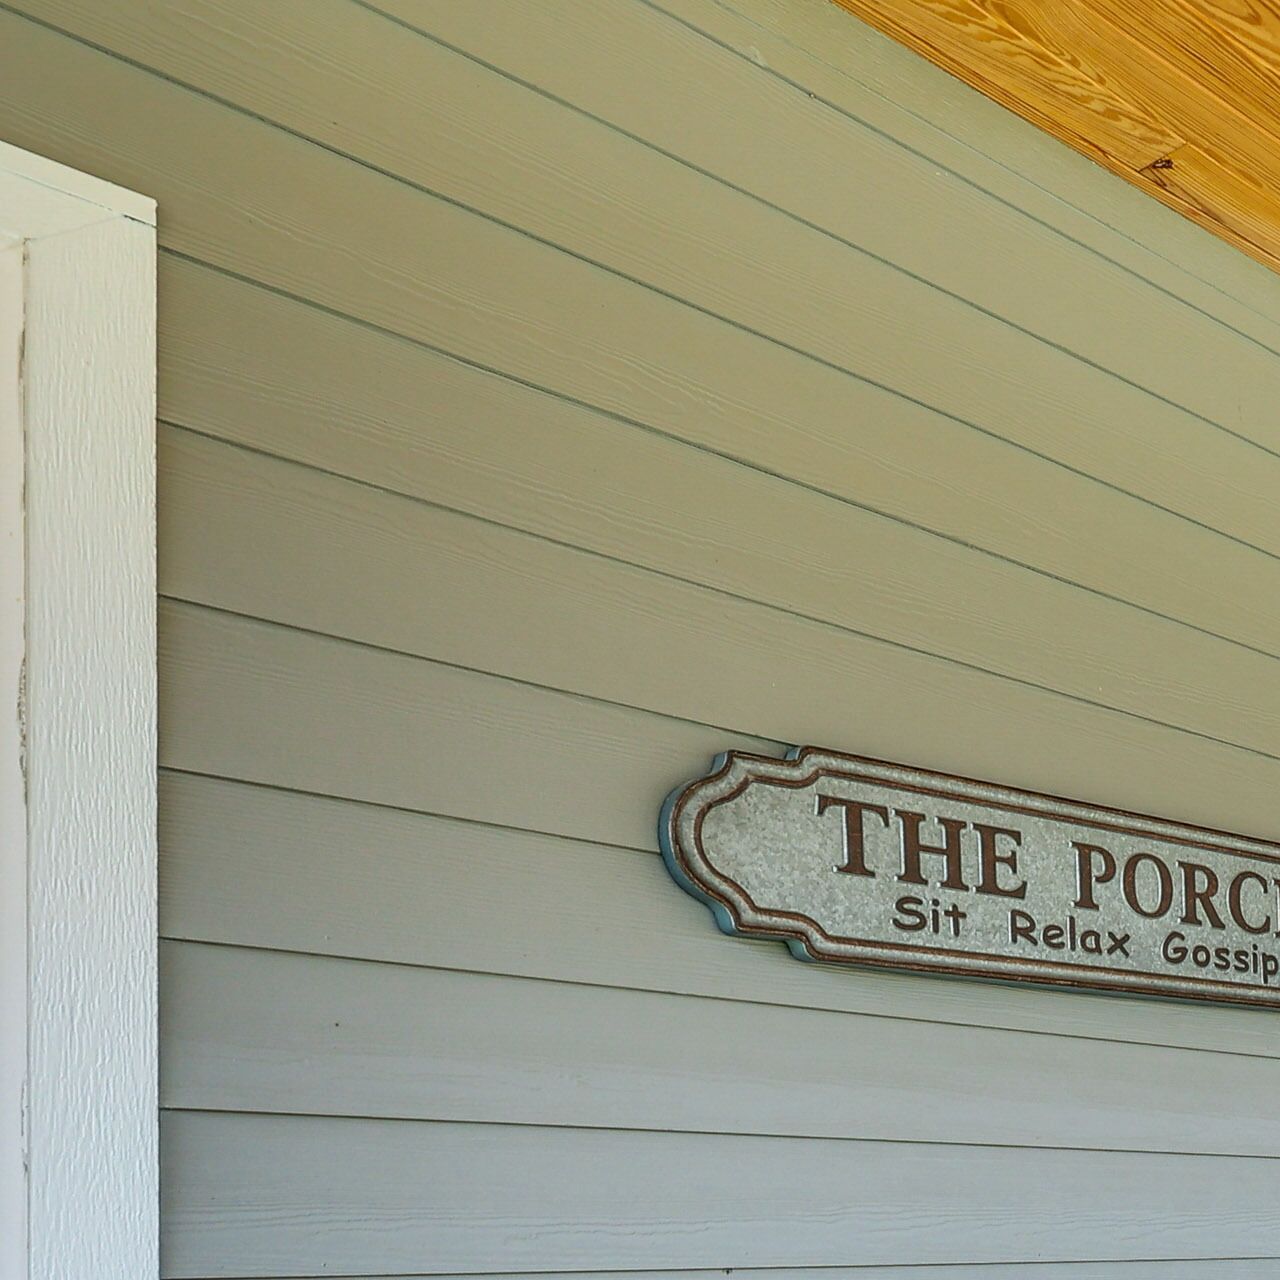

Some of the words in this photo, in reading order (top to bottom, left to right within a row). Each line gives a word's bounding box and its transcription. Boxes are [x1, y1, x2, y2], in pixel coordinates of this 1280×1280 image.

[816, 793, 1029, 900] THE
[892, 896, 968, 938] Sit
[1010, 909, 1131, 959] Relax
[1162, 931, 1279, 985] Gossip
